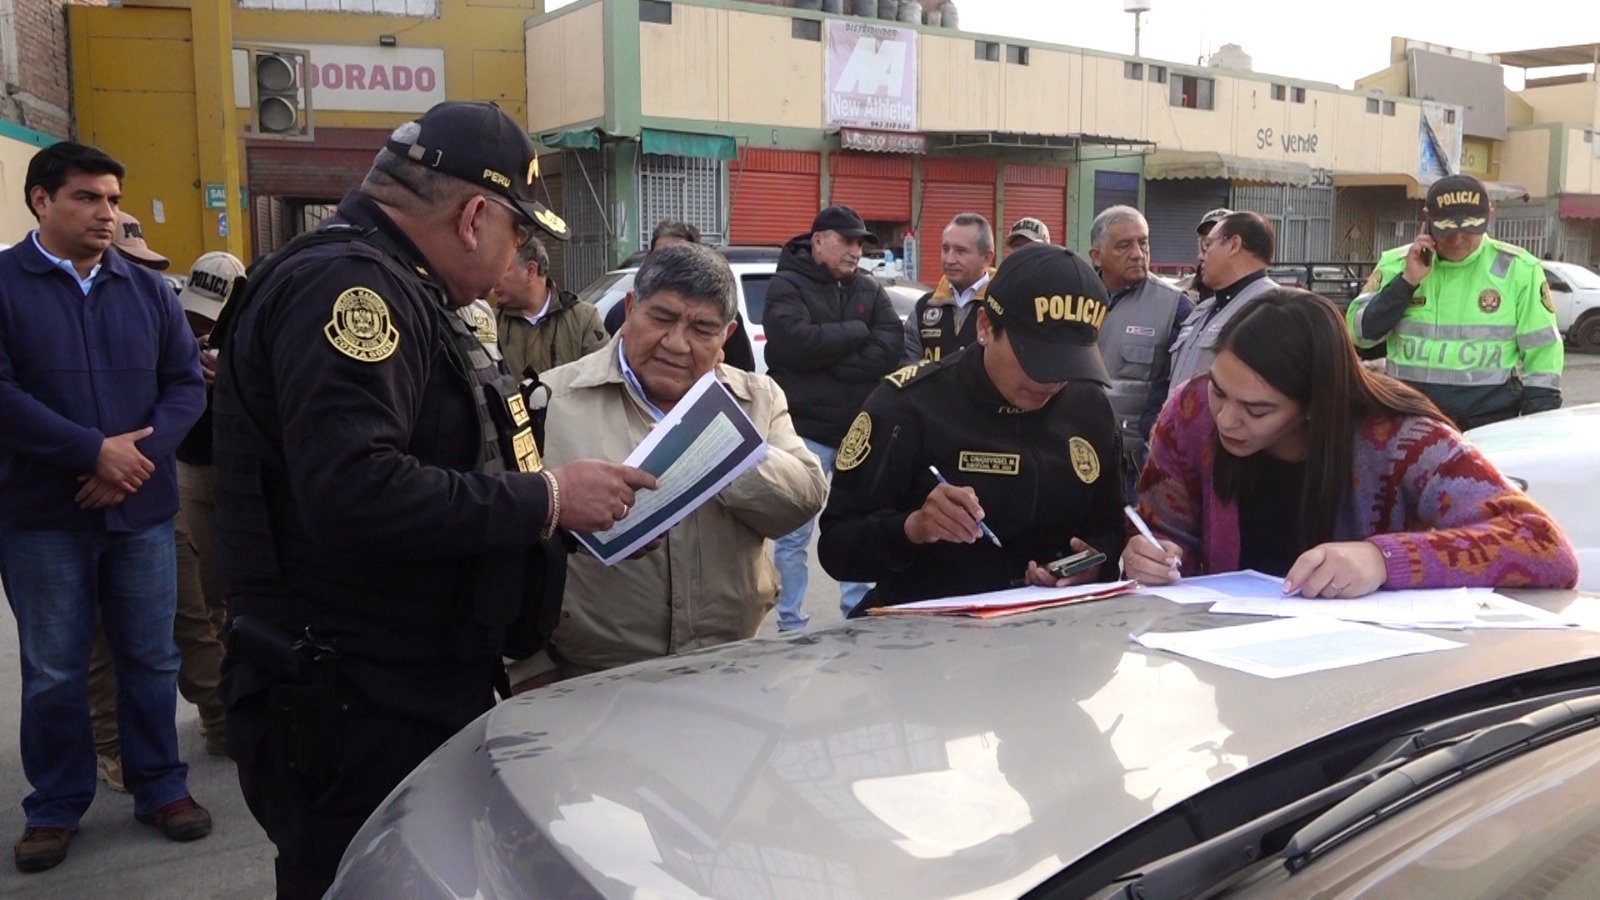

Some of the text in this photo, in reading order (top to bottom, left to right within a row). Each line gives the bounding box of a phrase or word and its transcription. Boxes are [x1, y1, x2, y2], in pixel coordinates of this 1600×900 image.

[299, 63, 436, 93] DORADO
[831, 92, 912, 122] New Athletic
[483, 169, 511, 188] PERU
[1436, 191, 1480, 208] POLICIA
[1034, 295, 1107, 331] POLICIA
